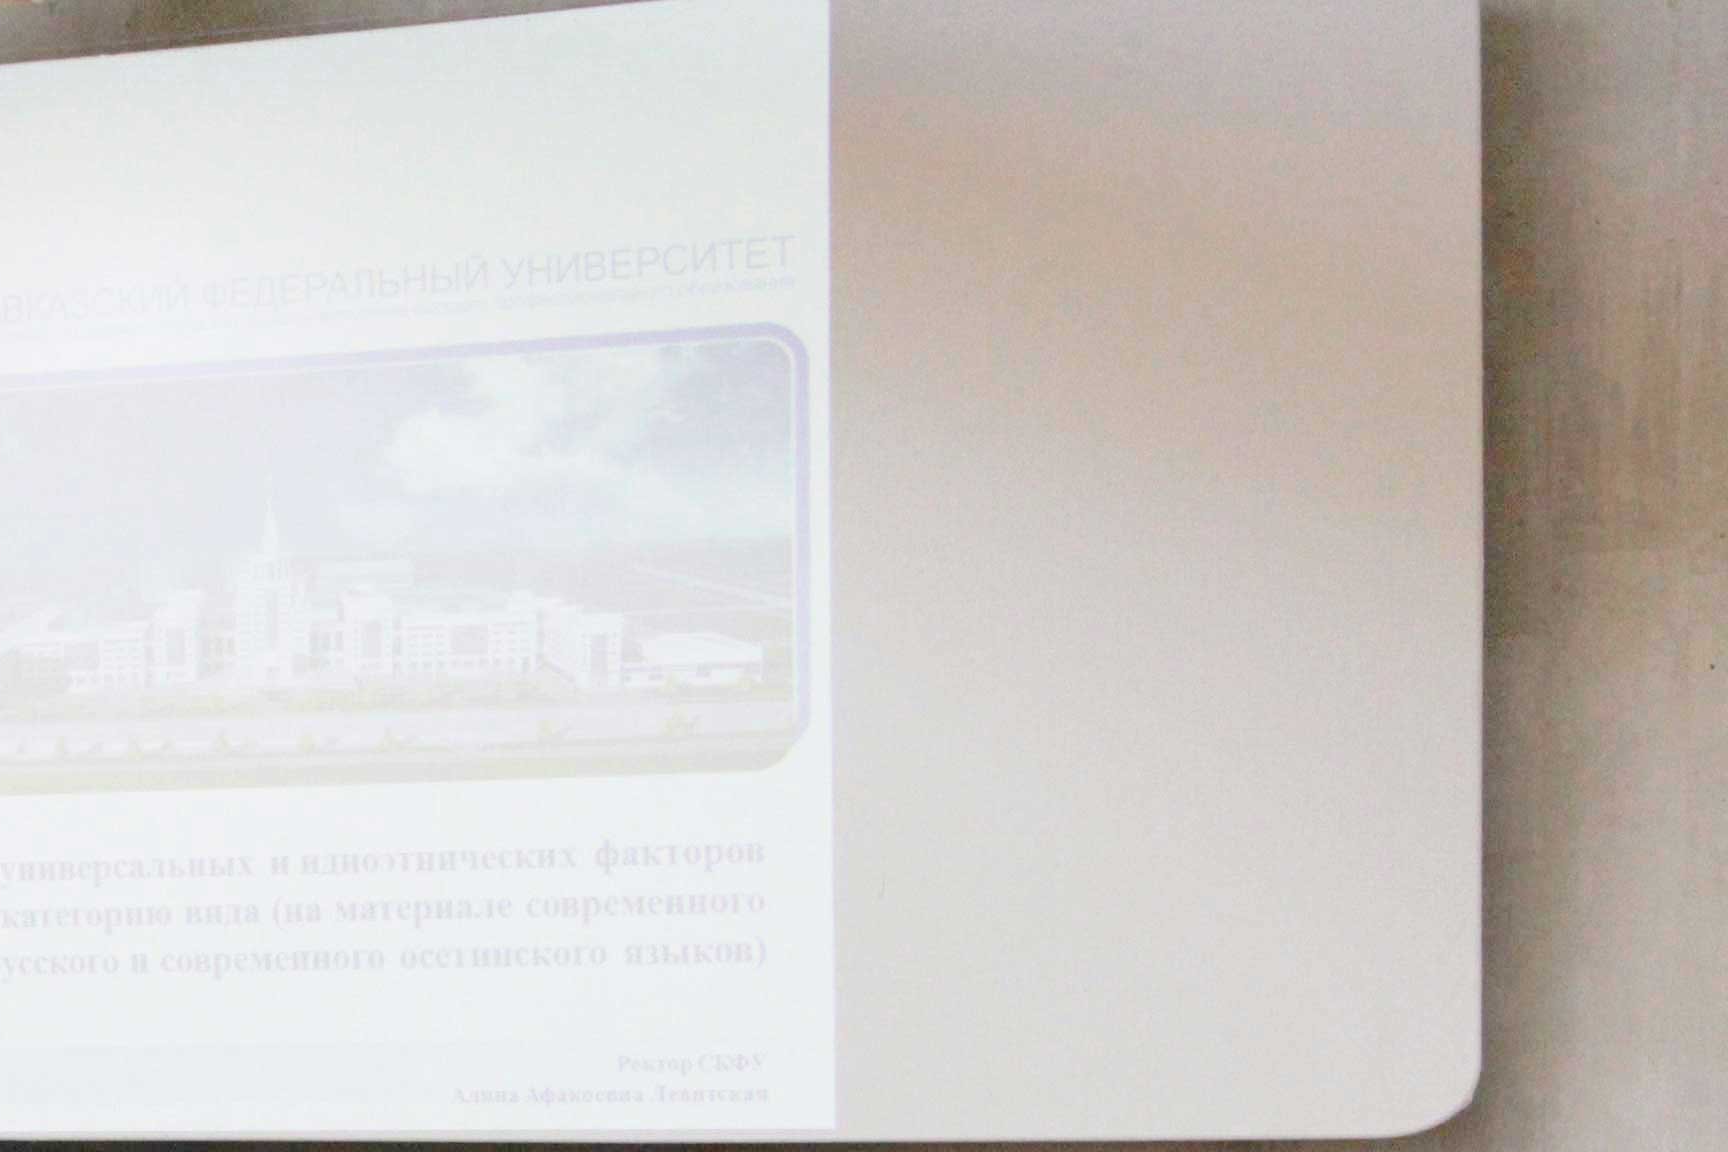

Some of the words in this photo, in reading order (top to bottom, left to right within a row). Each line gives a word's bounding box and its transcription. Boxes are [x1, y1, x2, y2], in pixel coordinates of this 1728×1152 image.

[202, 254, 489, 311] ФЕДЕРАЛЬНЫЙ
[499, 234, 797, 289] УНИВЕРСИТЕТ
[0, 853, 255, 889] универсальных
[270, 855, 290, 877] и
[593, 836, 767, 877] факторов
[0, 904, 173, 936] категорию
[185, 903, 261, 928] вида
[271, 899, 323, 932] (на
[334, 895, 514, 931] материале
[525, 889, 766, 927] современного
[130, 951, 151, 976] и
[160, 947, 386, 981] современного
[399, 943, 607, 969] осетинского
[623, 936, 768, 970] языков)
[617, 1055, 695, 1077] Ректор
[698, 1050, 769, 1073] СКФУ
